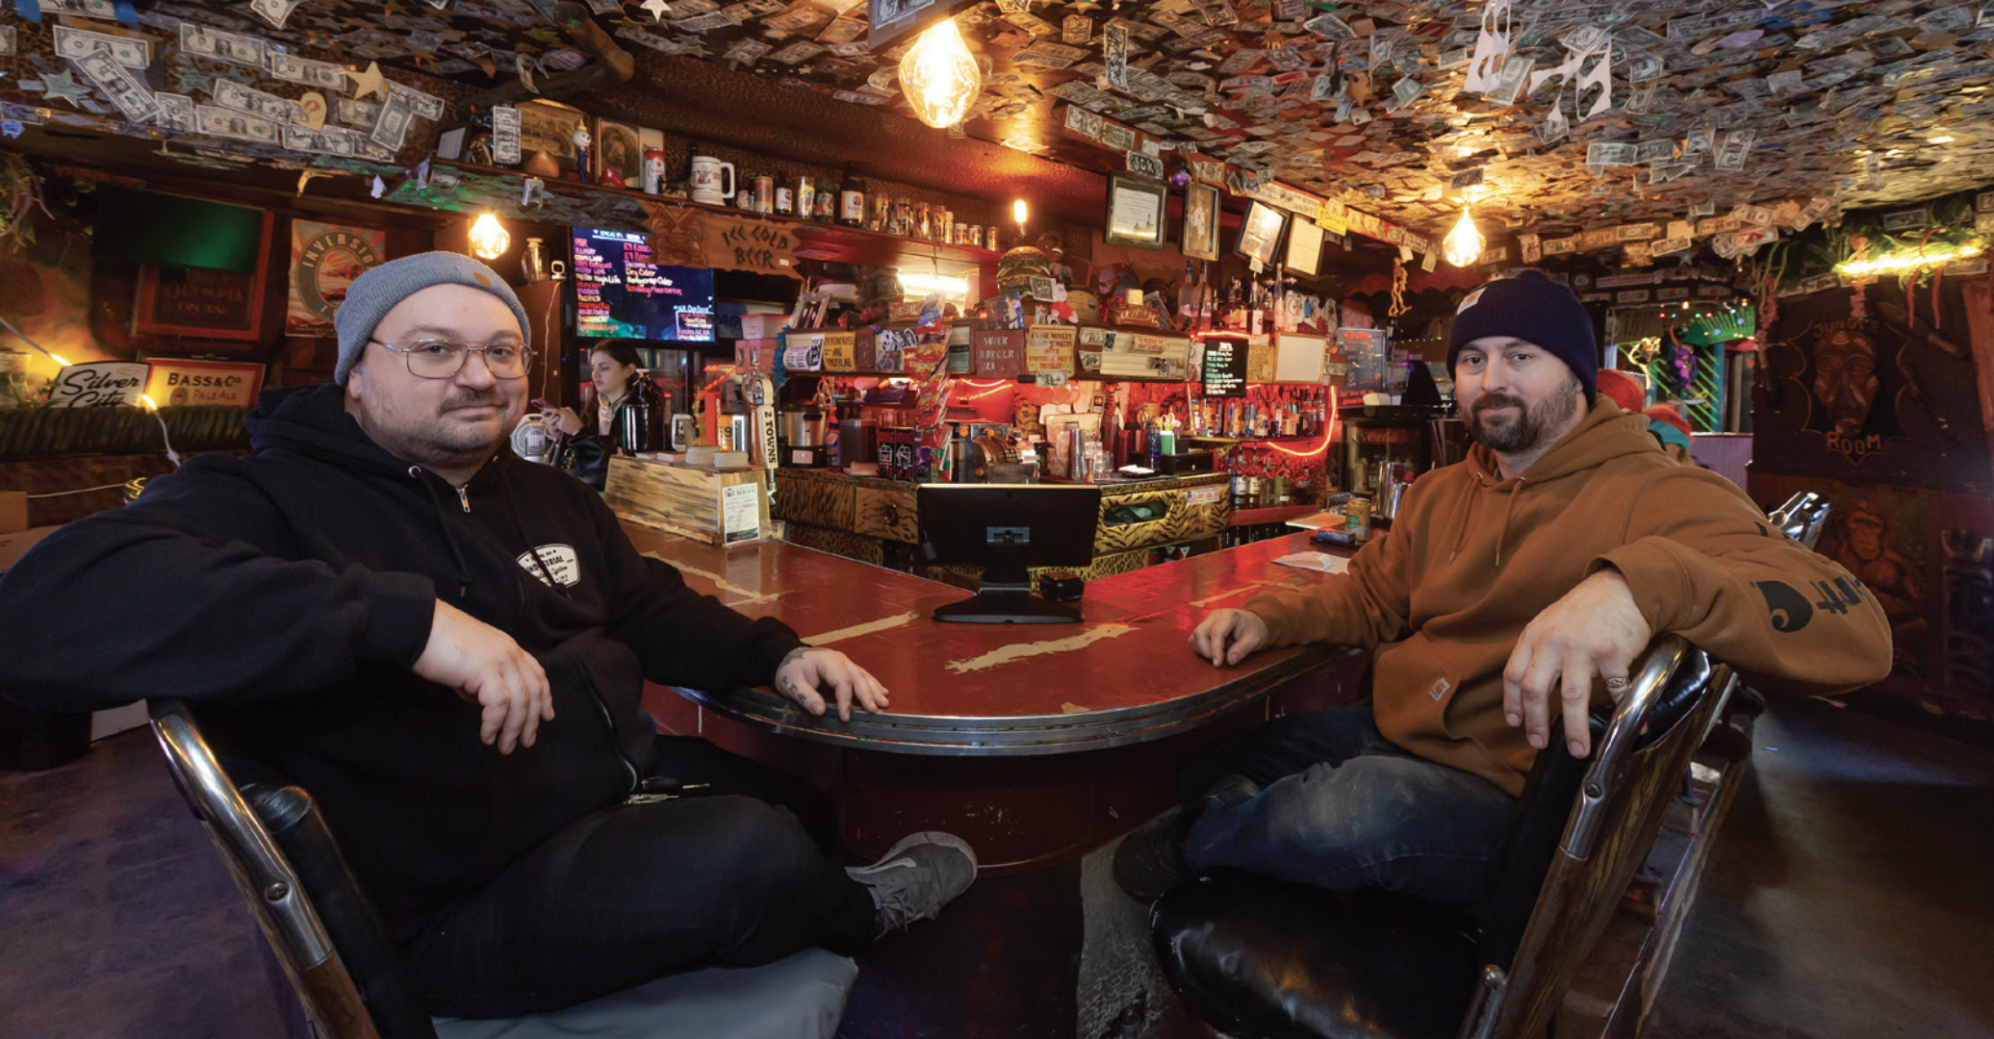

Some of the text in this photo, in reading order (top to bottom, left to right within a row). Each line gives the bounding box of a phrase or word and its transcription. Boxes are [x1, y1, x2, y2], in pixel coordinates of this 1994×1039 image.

[751, 224, 788, 249] COLD
[301, 233, 378, 270] INVERSID
[60, 369, 140, 396] Silver
[218, 390, 237, 400] ALE
[67, 388, 127, 408] City
[765, 420, 776, 464] TOWNS
[1826, 431, 1882, 455] ROOM
